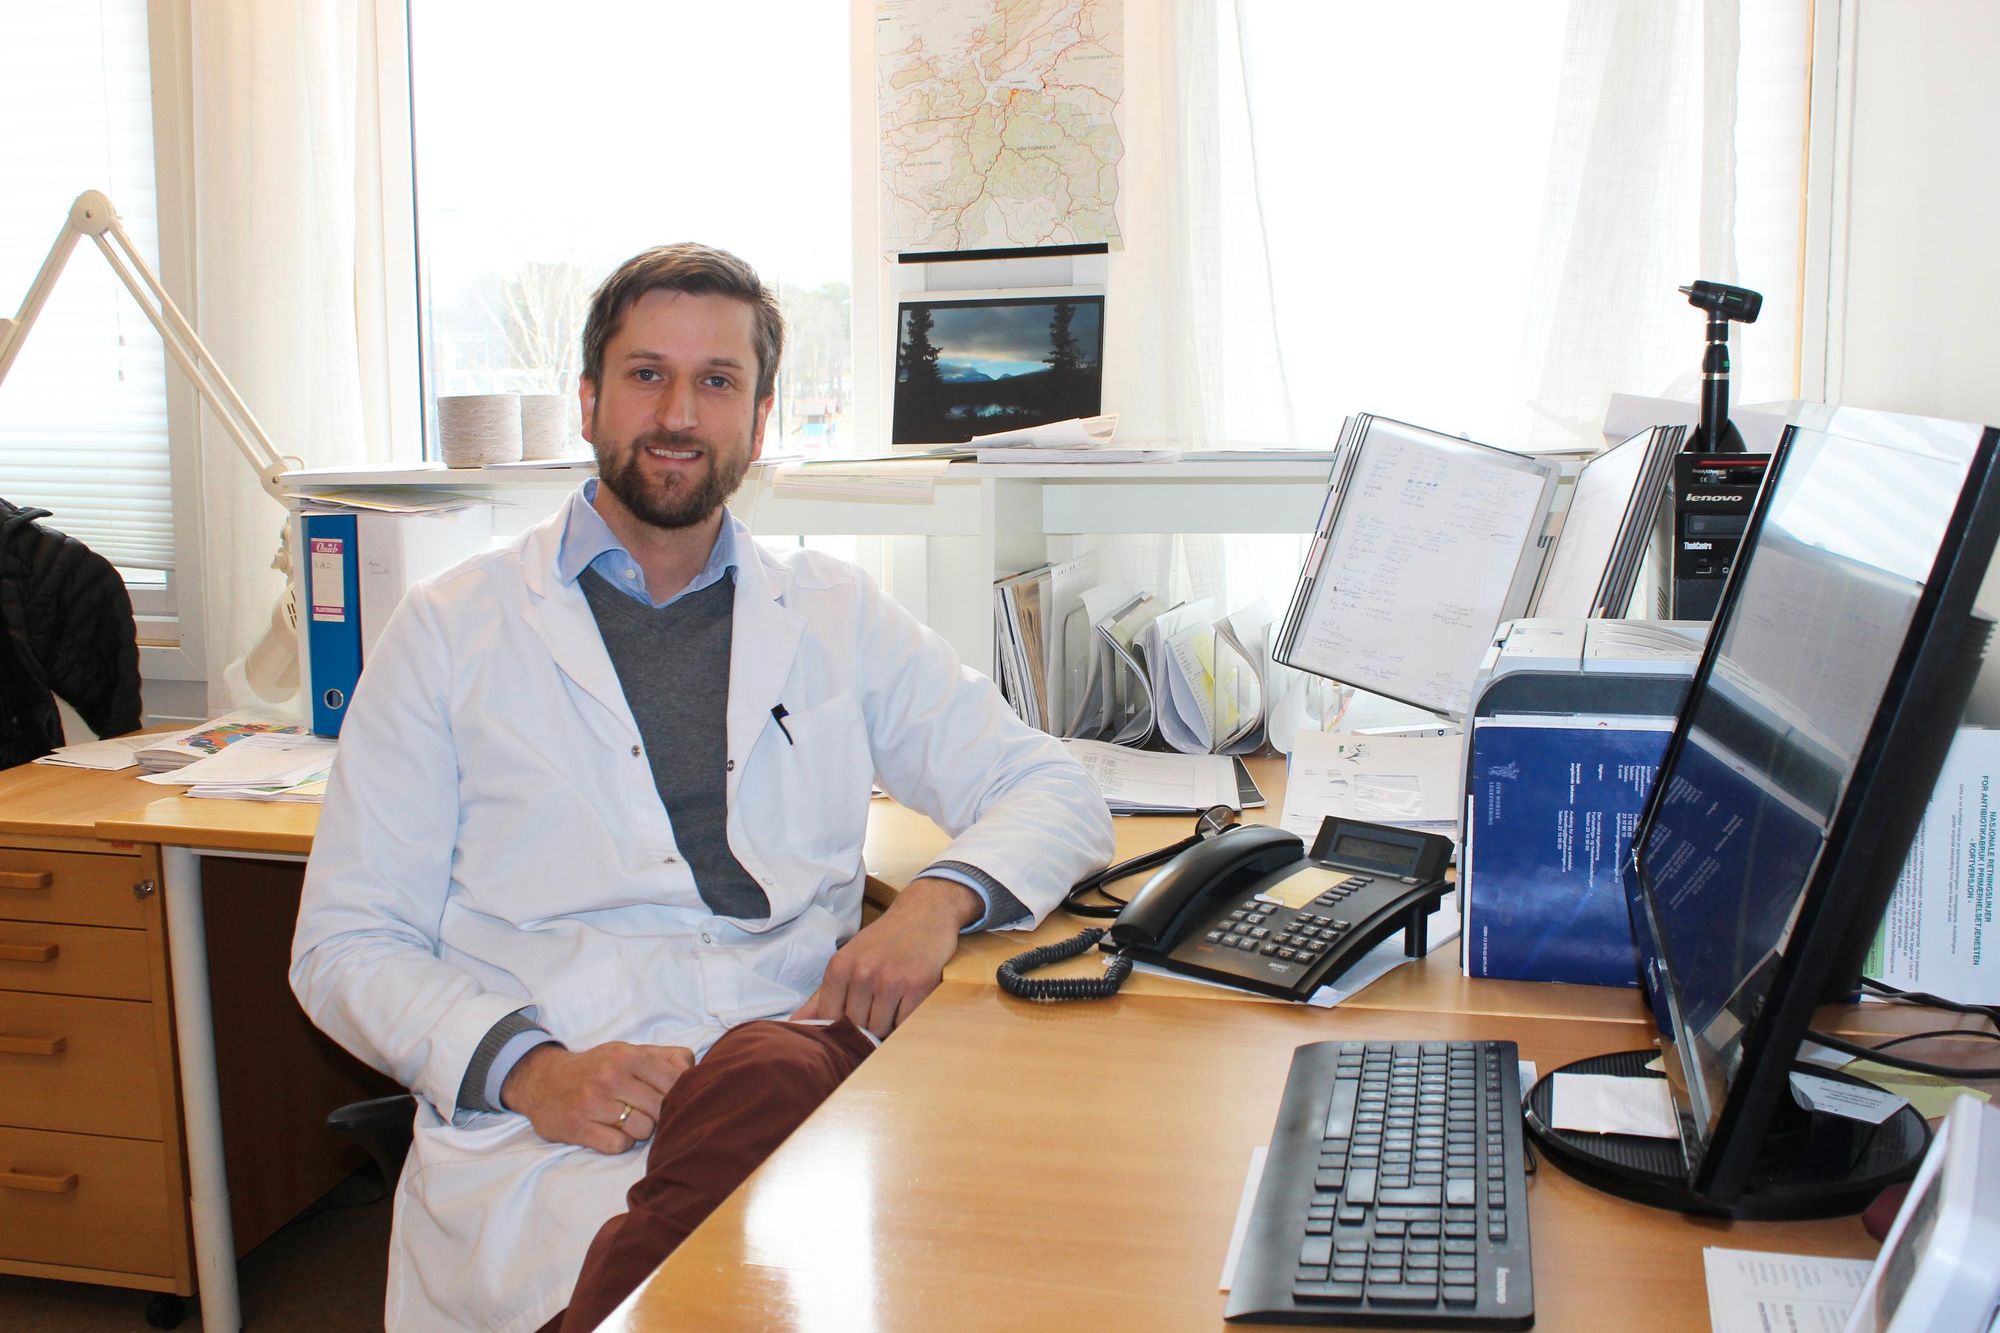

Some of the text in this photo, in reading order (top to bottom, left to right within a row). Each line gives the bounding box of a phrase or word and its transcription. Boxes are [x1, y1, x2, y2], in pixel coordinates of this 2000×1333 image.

[1686, 493, 1743, 502] lenovo
[1981, 775, 1989, 791] FOR
[1978, 793, 1988, 862] ANTIBIOTIKABRUK
[1967, 842, 1976, 898] KORTVERSJON
[1984, 811, 1996, 923] NASJONALE RETNINGSLINJER
[1973, 867, 1984, 966] PRIMÆRHELSETJENESTEN
[1496, 1267, 1510, 1304] lenovo
